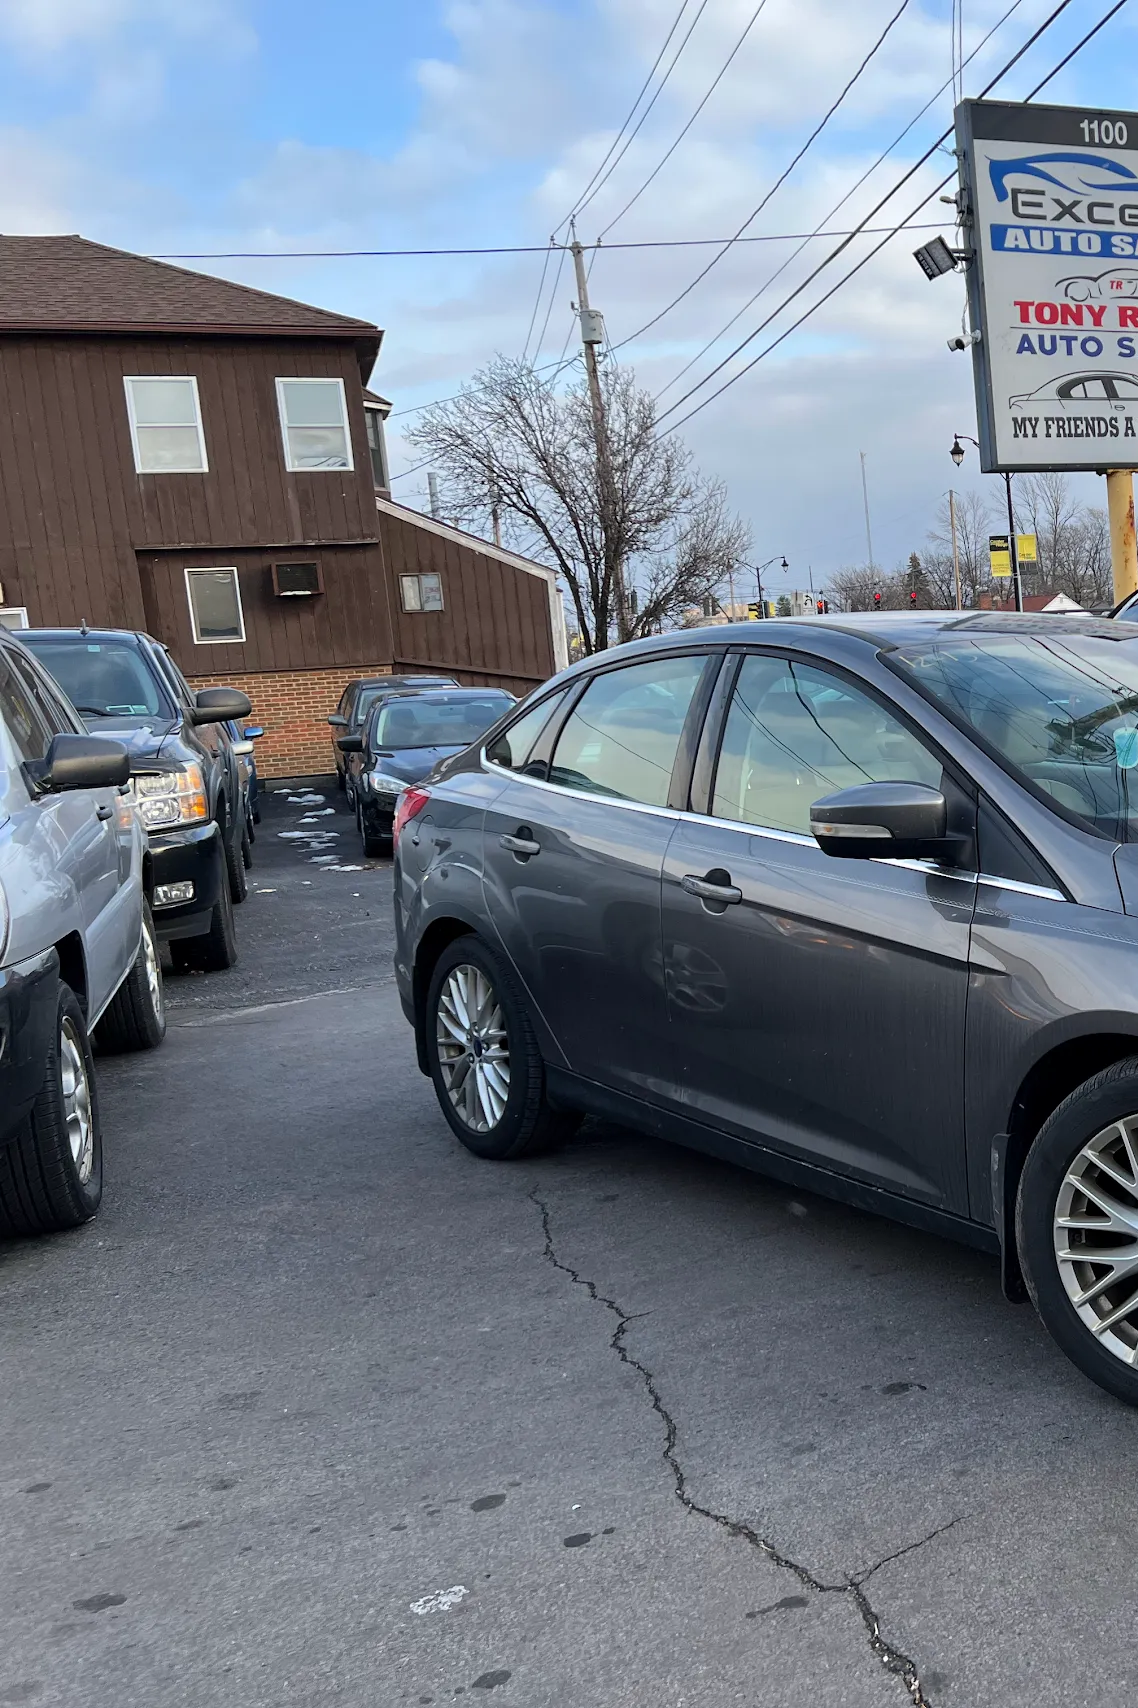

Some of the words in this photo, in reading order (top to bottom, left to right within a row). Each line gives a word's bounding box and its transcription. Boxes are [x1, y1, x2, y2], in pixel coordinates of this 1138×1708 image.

[1080, 119, 1128, 145] 1100
[1004, 228, 1101, 254] AUTO
[1109, 280, 1123, 290] TR
[1014, 301, 1107, 327] TONY
[1016, 334, 1103, 357] AUTO
[1012, 416, 1039, 438] MY
[1044, 416, 1120, 438] FRIENDS
[1124, 417, 1138, 437] A
